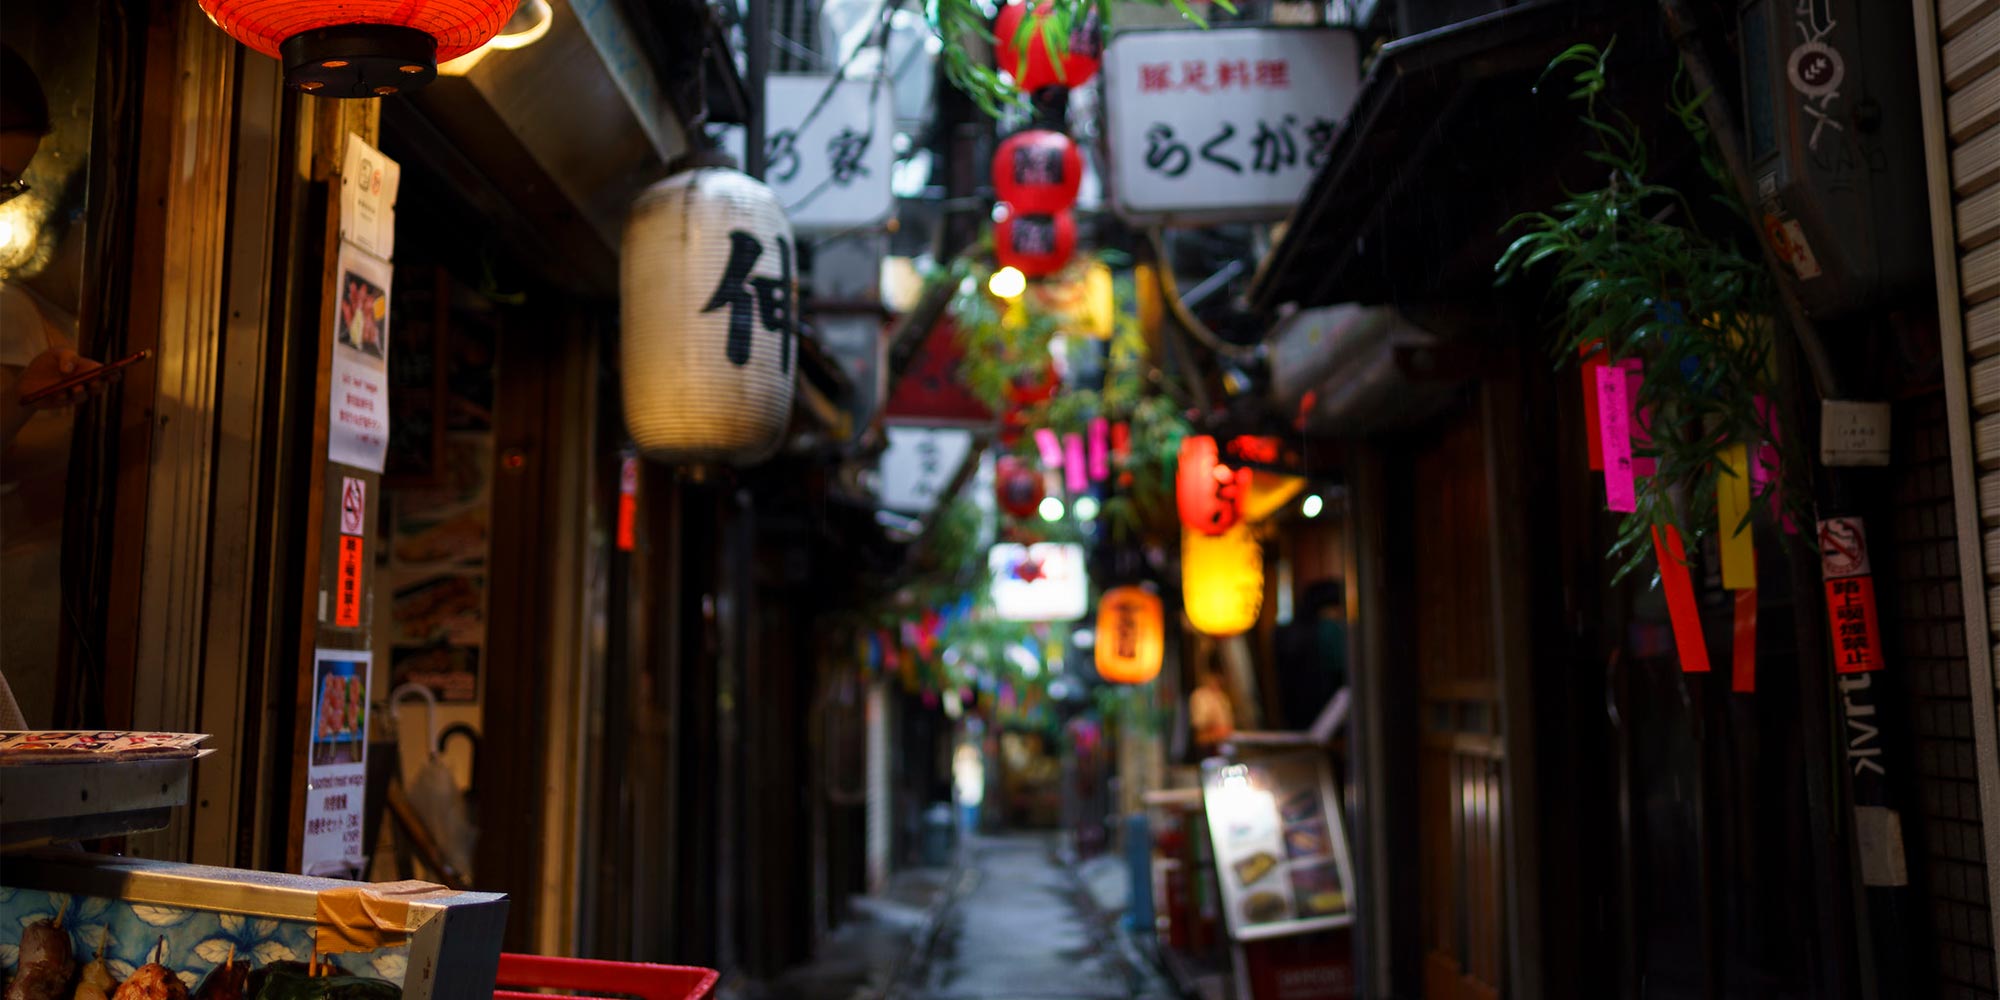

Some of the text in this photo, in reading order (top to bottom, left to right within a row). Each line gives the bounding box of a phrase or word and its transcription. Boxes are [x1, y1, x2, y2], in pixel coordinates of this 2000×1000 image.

[1833, 580, 1872, 664] 路上喫煙禁止
